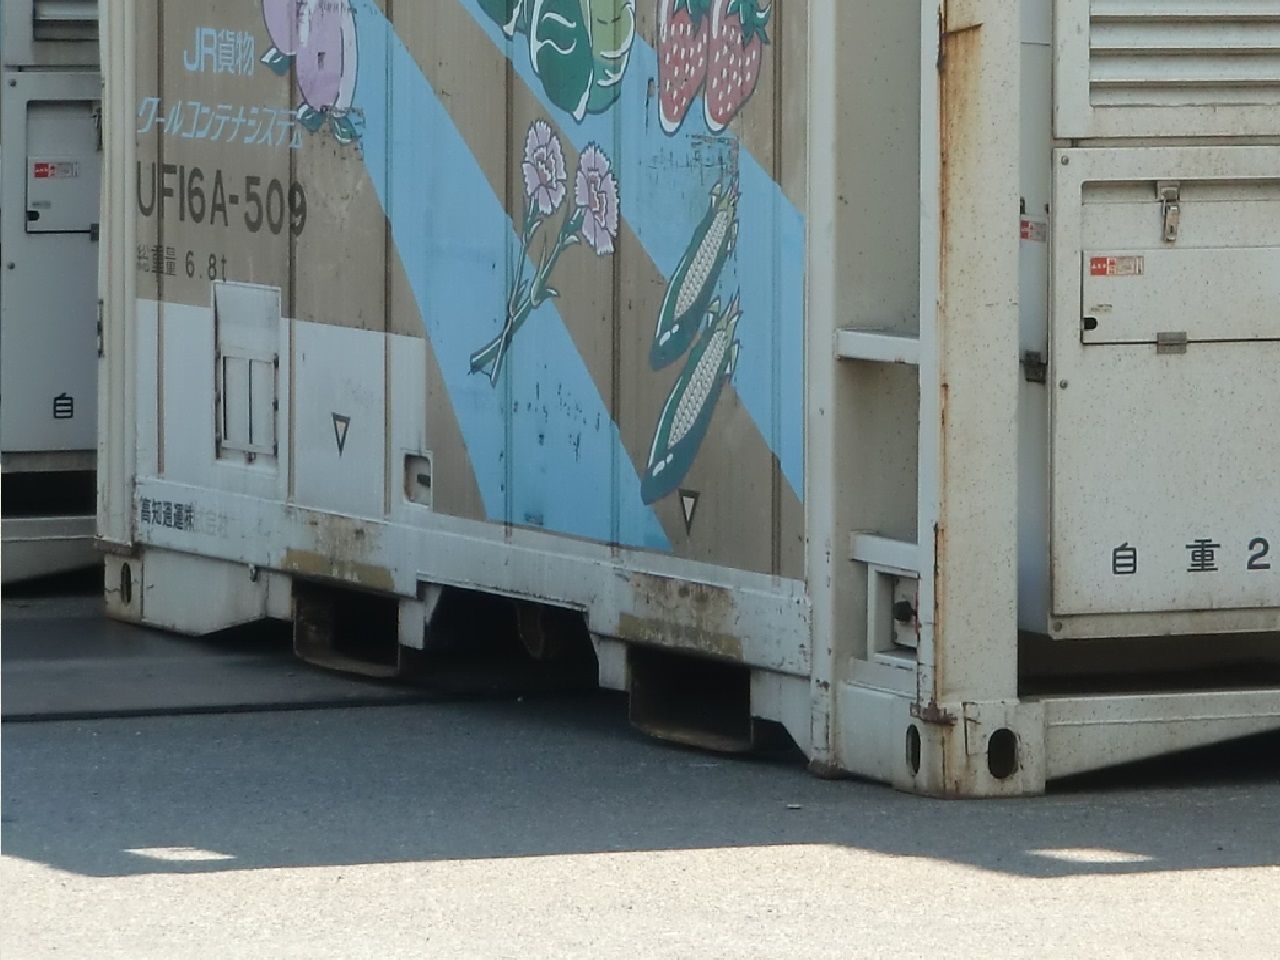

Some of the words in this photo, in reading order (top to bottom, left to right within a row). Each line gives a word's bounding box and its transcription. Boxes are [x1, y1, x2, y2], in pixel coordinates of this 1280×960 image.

[183, 25, 255, 76] JR貨物
[136, 160, 308, 237] UF16A-509
[53, 392, 74, 419] 自
